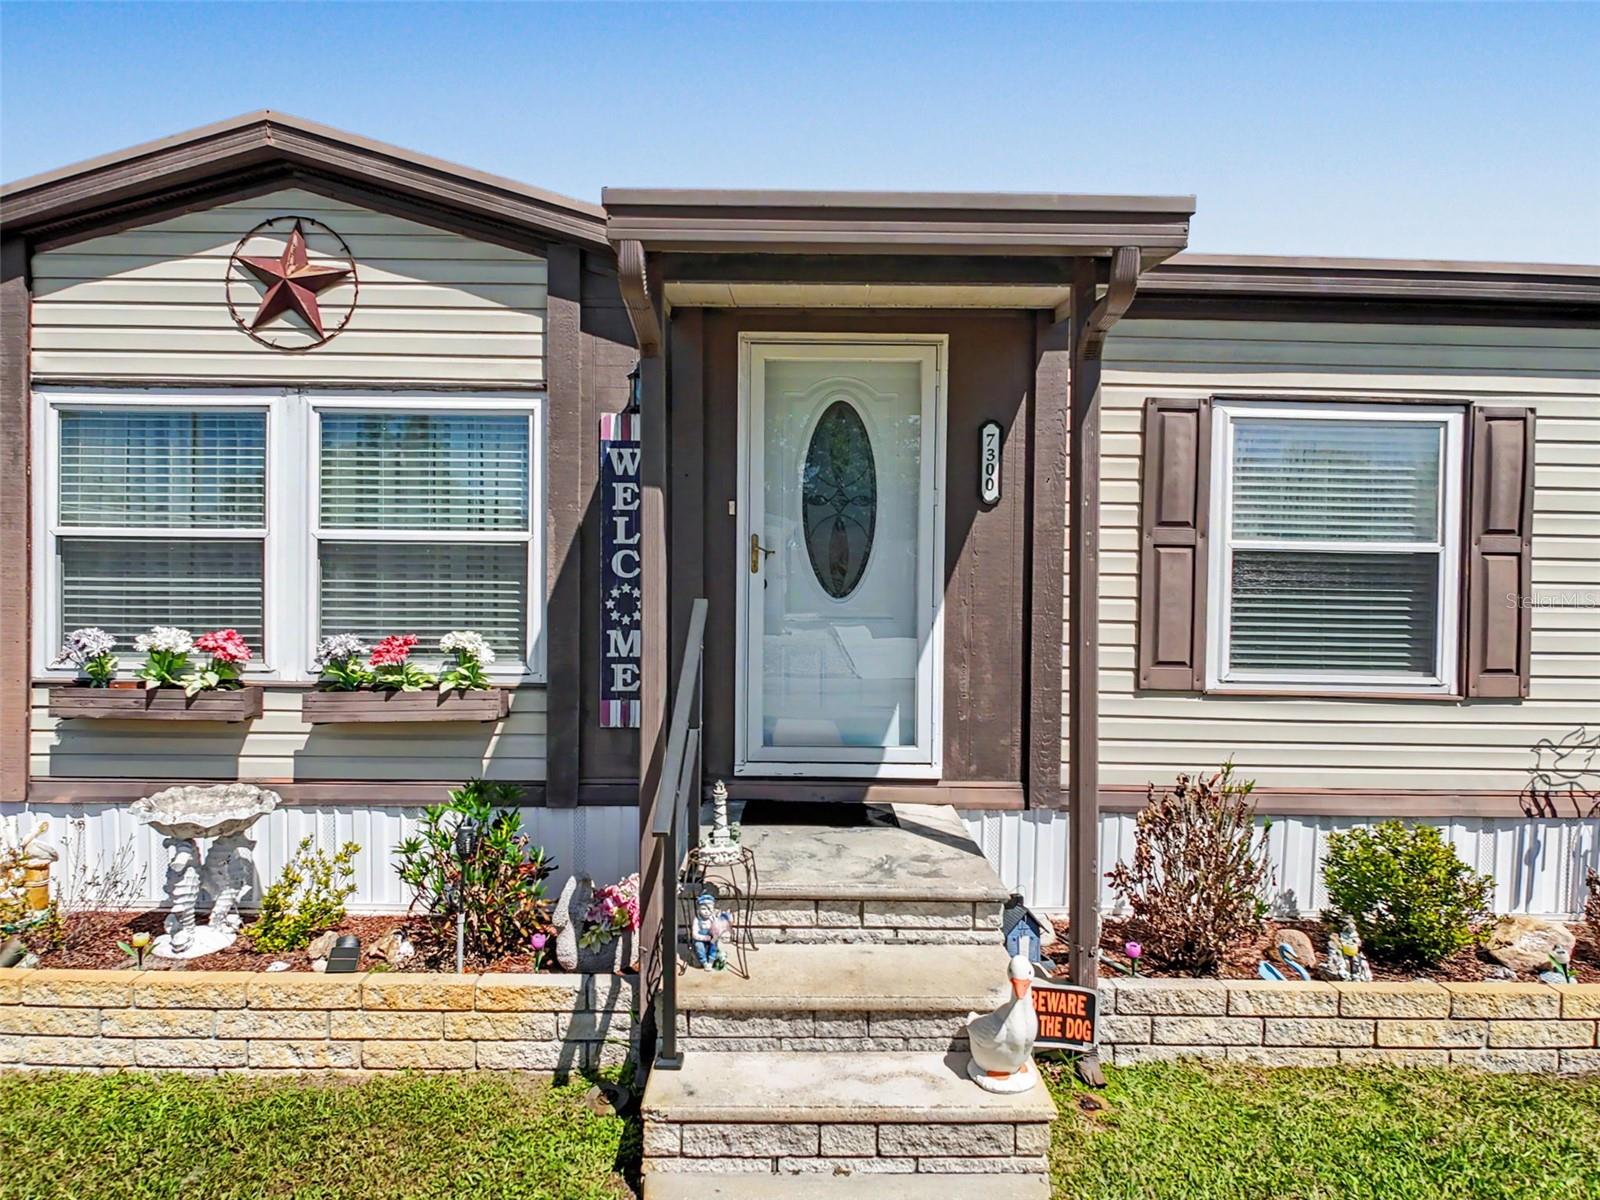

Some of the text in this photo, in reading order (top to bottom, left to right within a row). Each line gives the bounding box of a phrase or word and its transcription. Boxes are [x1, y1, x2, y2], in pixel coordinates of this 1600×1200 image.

[985, 433, 996, 492] 7300
[1031, 990, 1087, 1016] BEWARE
[1039, 1015, 1092, 1042] THE DOG
